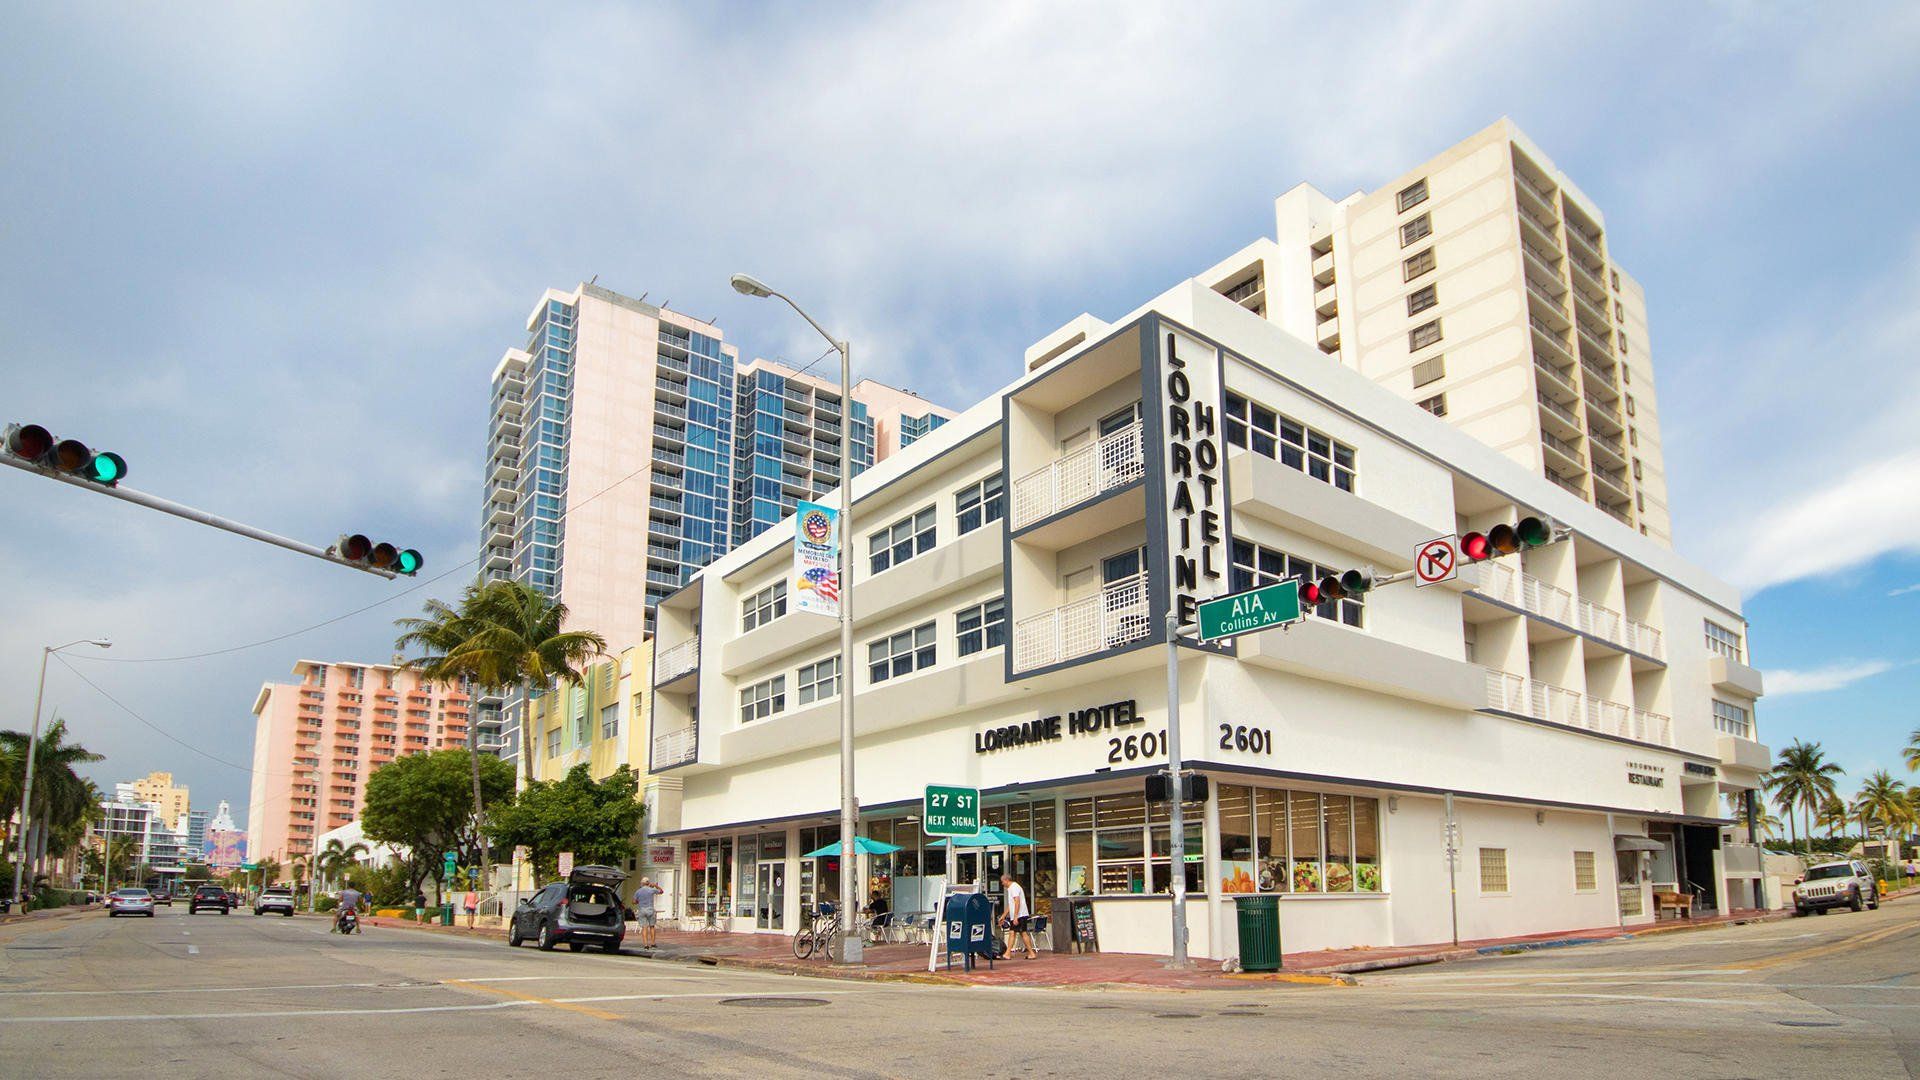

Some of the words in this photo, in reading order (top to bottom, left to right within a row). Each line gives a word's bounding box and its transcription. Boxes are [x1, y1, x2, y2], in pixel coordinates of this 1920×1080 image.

[1167, 332, 1197, 626] LORRAINE
[1194, 400, 1220, 579] HOTEL
[1232, 594, 1264, 618] A1A
[1220, 616, 1259, 633] Collins
[1263, 611, 1277, 623] Av
[975, 716, 1062, 753] LORRAINE
[1069, 699, 1145, 735] HOTEL
[1219, 723, 1272, 755] 2601
[1108, 729, 1168, 764] 2601
[1628, 773, 1664, 788] RESTAURANT
[931, 794, 949, 807] 27
[957, 795, 973, 809] ST
[928, 815, 946, 826] NEXT
[951, 816, 976, 827] SIGNAL
